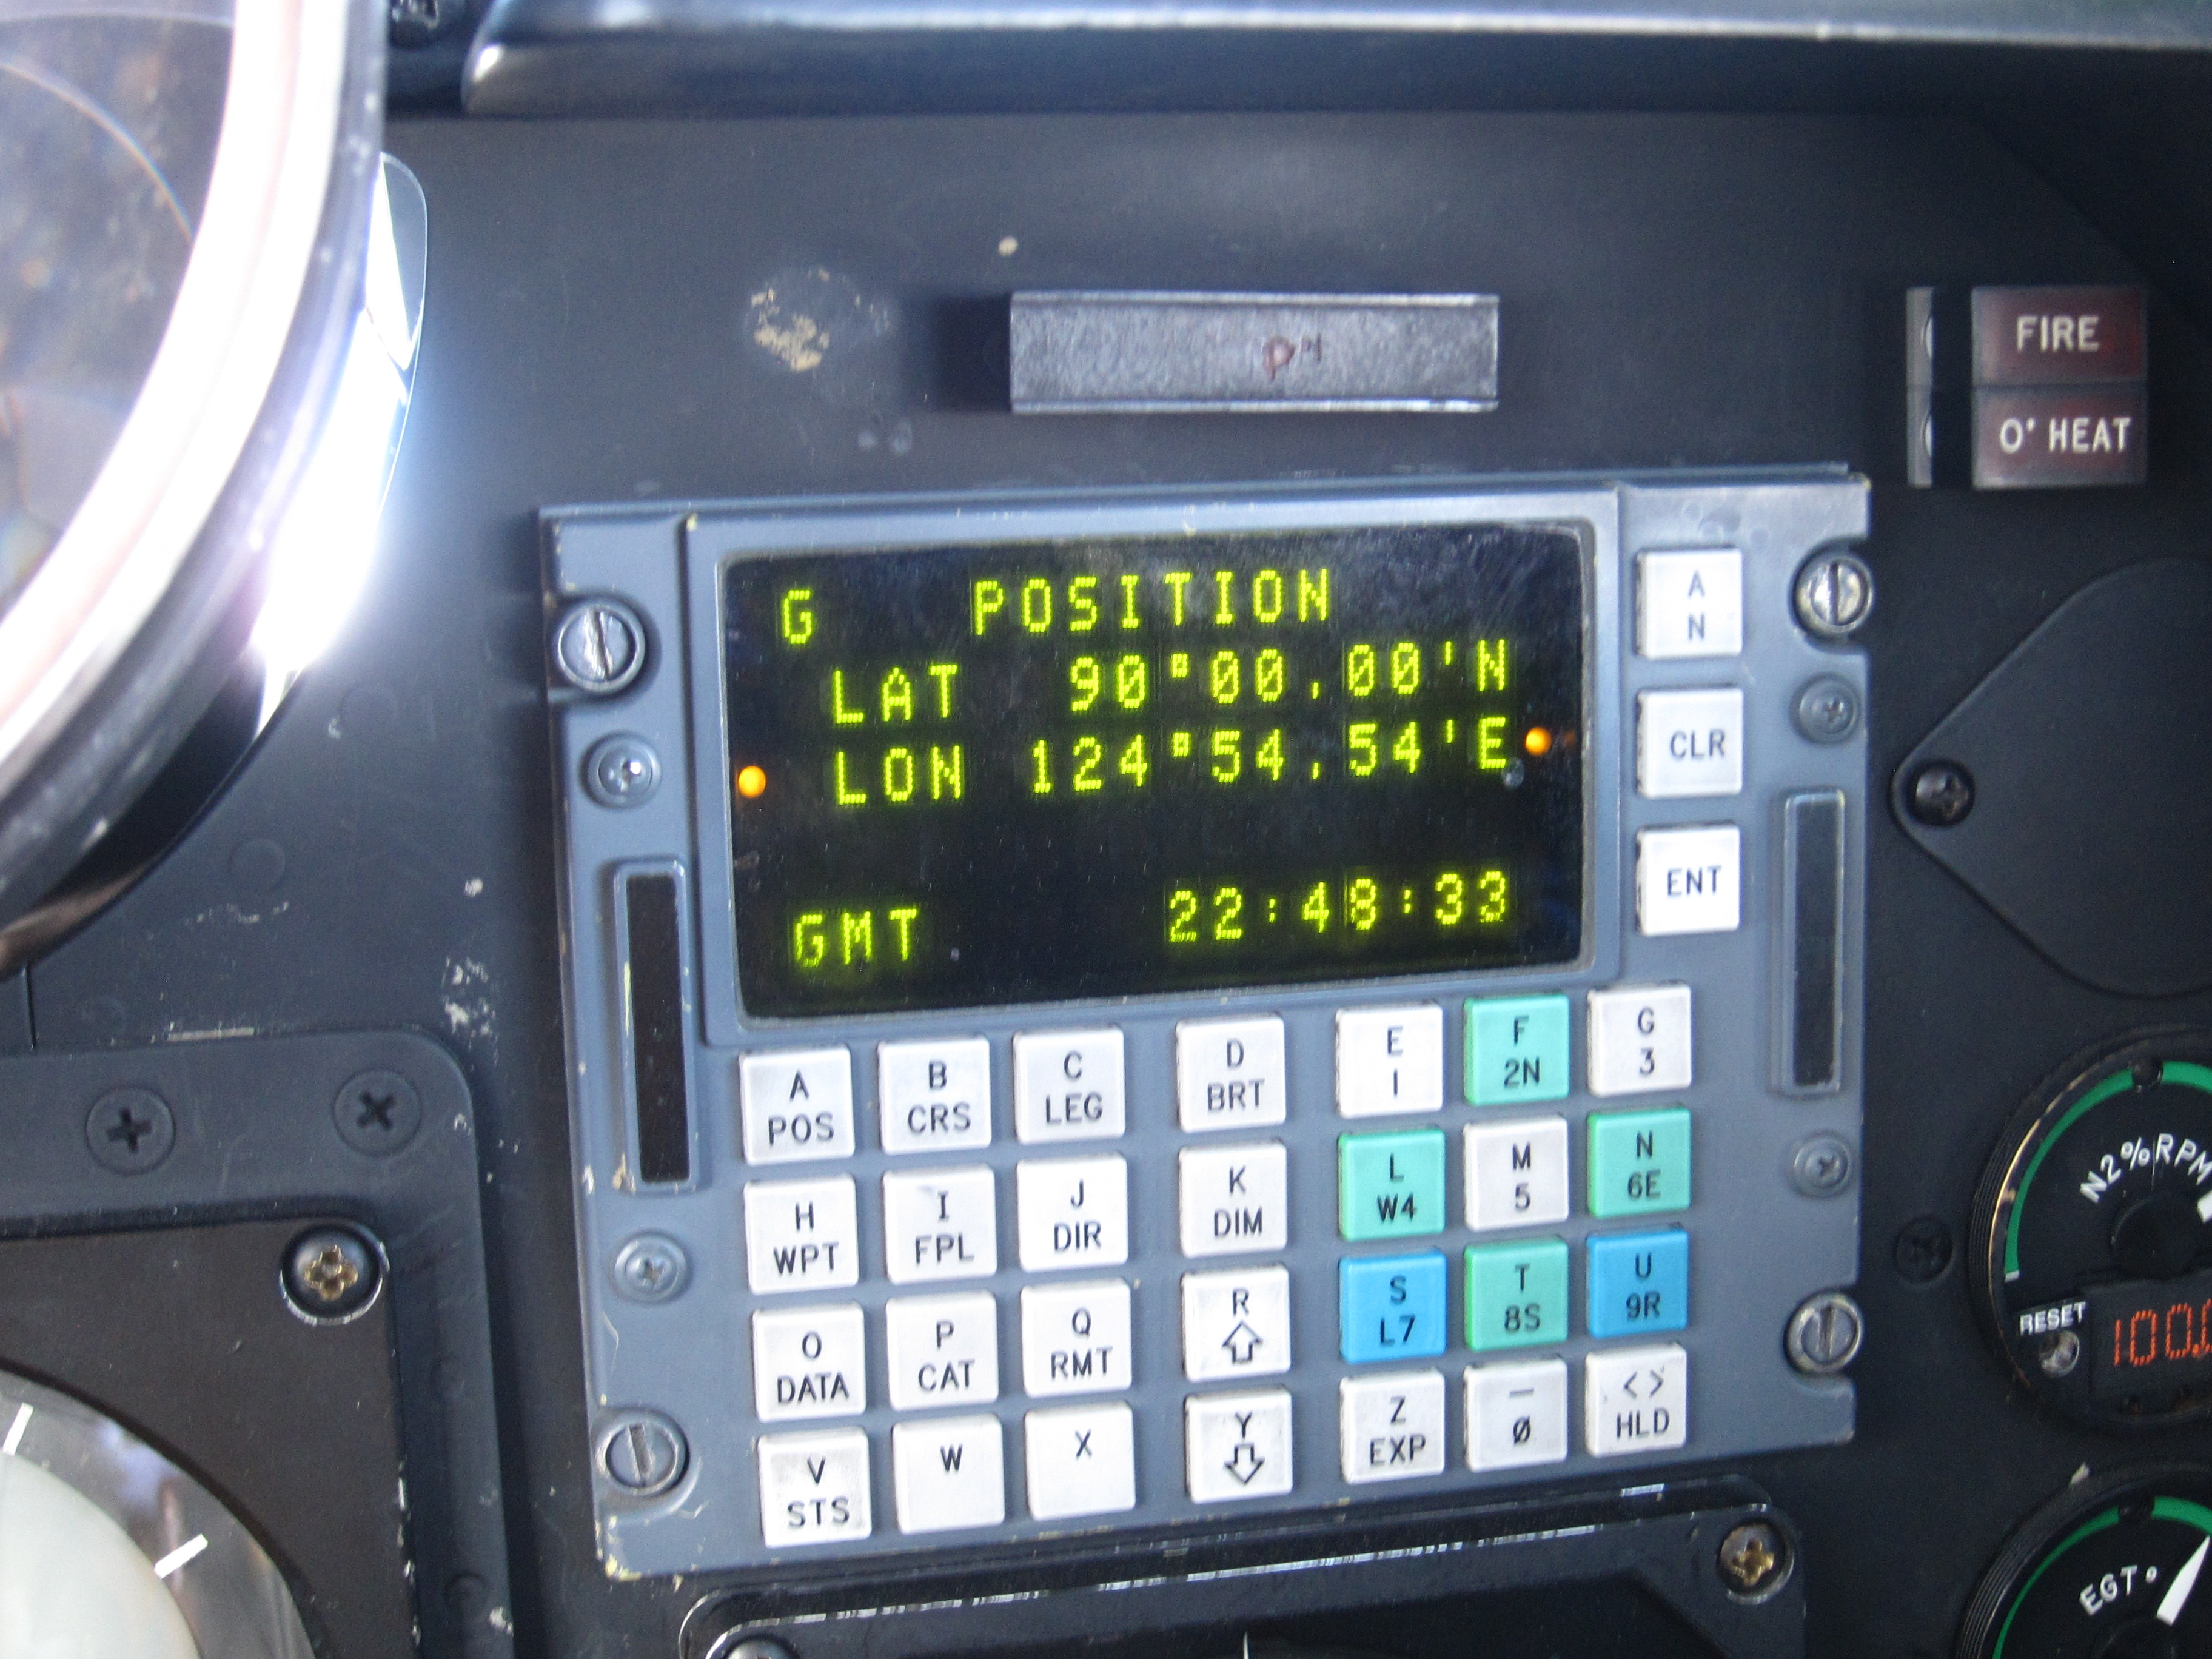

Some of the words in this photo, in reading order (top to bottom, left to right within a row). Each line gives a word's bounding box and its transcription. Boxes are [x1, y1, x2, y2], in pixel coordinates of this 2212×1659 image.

[2017, 315, 2099, 352] FIRE
[2049, 417, 2130, 452] HEAT
[1687, 571, 1705, 597] A
[782, 588, 814, 646] G
[974, 569, 1330, 635] POSITION
[1688, 614, 1705, 640] N
[831, 663, 958, 725] LAT
[1669, 729, 1726, 760] CLR
[836, 745, 962, 805] LON
[1667, 865, 1722, 896] ENT
[794, 908, 919, 967] GMT
[1169, 870, 1507, 942] 22:48:33
[1513, 1017, 1529, 1045] F
[1637, 1008, 1655, 1035] G
[1227, 1039, 1244, 1068] D
[1387, 1028, 1403, 1056] E
[928, 1062, 947, 1089] B
[1064, 1052, 1082, 1079] C
[1504, 1058, 1540, 1088] 2N
[1640, 1048, 1655, 1075] 3
[789, 1071, 809, 1100] A
[1207, 1080, 1264, 1111] BRT
[907, 1104, 971, 1134] CRS
[1045, 1094, 1103, 1124] LEG
[768, 1114, 834, 1146] POS
[1512, 1143, 1532, 1170] M
[1636, 1131, 1653, 1159] N
[1229, 1167, 1246, 1194] K
[1389, 1154, 1404, 1181] L
[1070, 1181, 1085, 1208] J
[1515, 1184, 1531, 1211] 5
[1627, 1171, 1660, 1198] 6E
[795, 1203, 814, 1230] H
[937, 1193, 949, 1220] I
[1377, 1194, 1416, 1222] W4
[1214, 1208, 1263, 1237] DIM
[915, 1234, 974, 1265] FPL
[1054, 1223, 1101, 1251] DIR
[773, 1242, 839, 1275] WPT
[1635, 1253, 1652, 1280] U
[1390, 1276, 1407, 1304] S
[1515, 1264, 1529, 1292] T
[1232, 1290, 1250, 1315] R
[1626, 1292, 1661, 1319] 9R
[1071, 1309, 1091, 1336] Q
[1380, 1315, 1415, 1345] L7
[1504, 1304, 1541, 1332] 8S
[2020, 1301, 2086, 1336] RESET
[936, 1322, 954, 1349] P
[918, 1360, 974, 1391] CAT
[1051, 1348, 1111, 1379] RMT
[777, 1373, 849, 1403] DATA
[1390, 1398, 1406, 1424] Z
[1617, 1409, 1670, 1439] HLD
[1234, 1412, 1252, 1439] Y
[940, 1445, 963, 1472] W
[1075, 1431, 1093, 1458] X
[1370, 1436, 1426, 1466] EXP
[807, 1458, 826, 1484] V
[787, 1499, 850, 1529] STS
